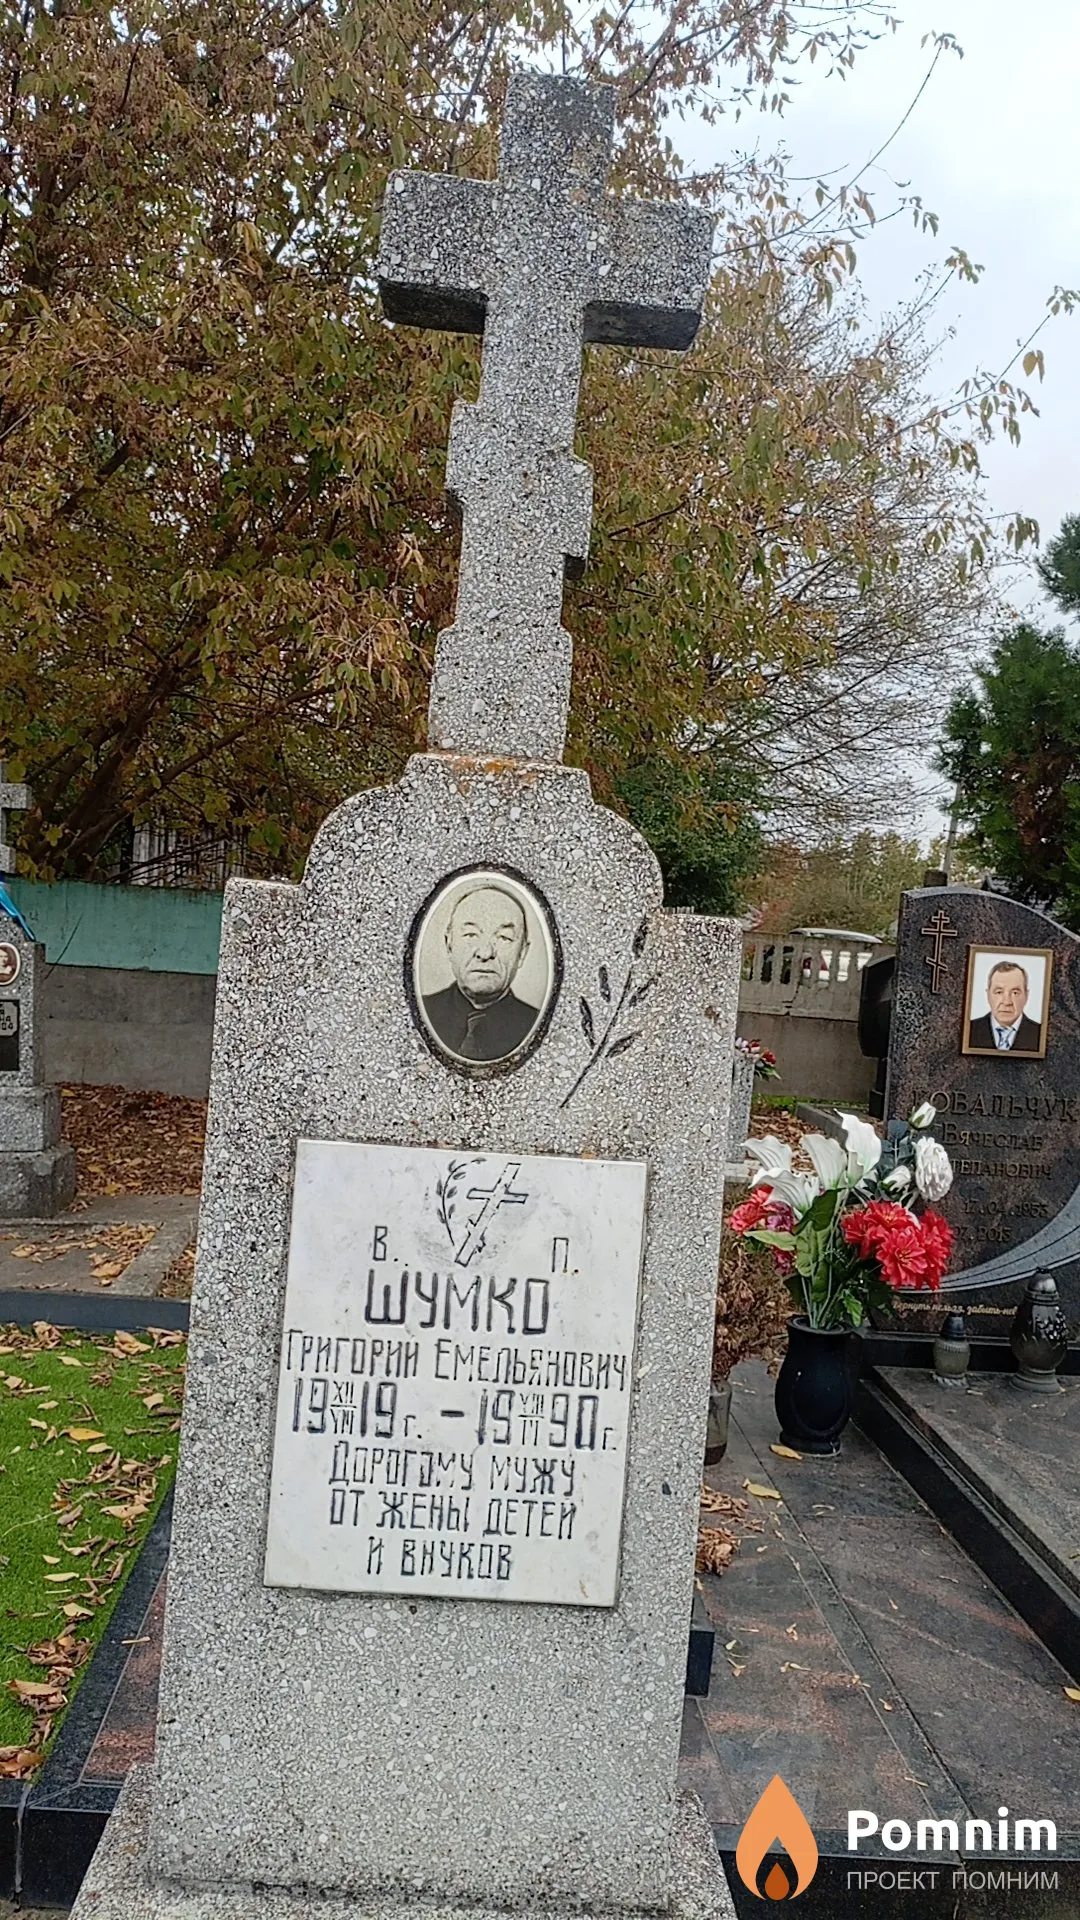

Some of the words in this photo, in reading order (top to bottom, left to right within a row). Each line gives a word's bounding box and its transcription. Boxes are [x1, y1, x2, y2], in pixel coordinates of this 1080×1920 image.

[951, 1159, 1052, 1180] ТЕПАНОВИЧ
[364, 1268, 550, 1335] ШУМКО
[434, 1338, 627, 1392] ЕМЕЛЬЯНОВИЧ
[328, 1440, 474, 1491] ДОРОГОМУ
[490, 1454, 576, 1497] МУЖУ
[329, 1488, 365, 1527] ОТ
[375, 1491, 470, 1533] ЖЕНЫ
[366, 1535, 384, 1575] И
[400, 1538, 513, 1581] ВНУКОВ
